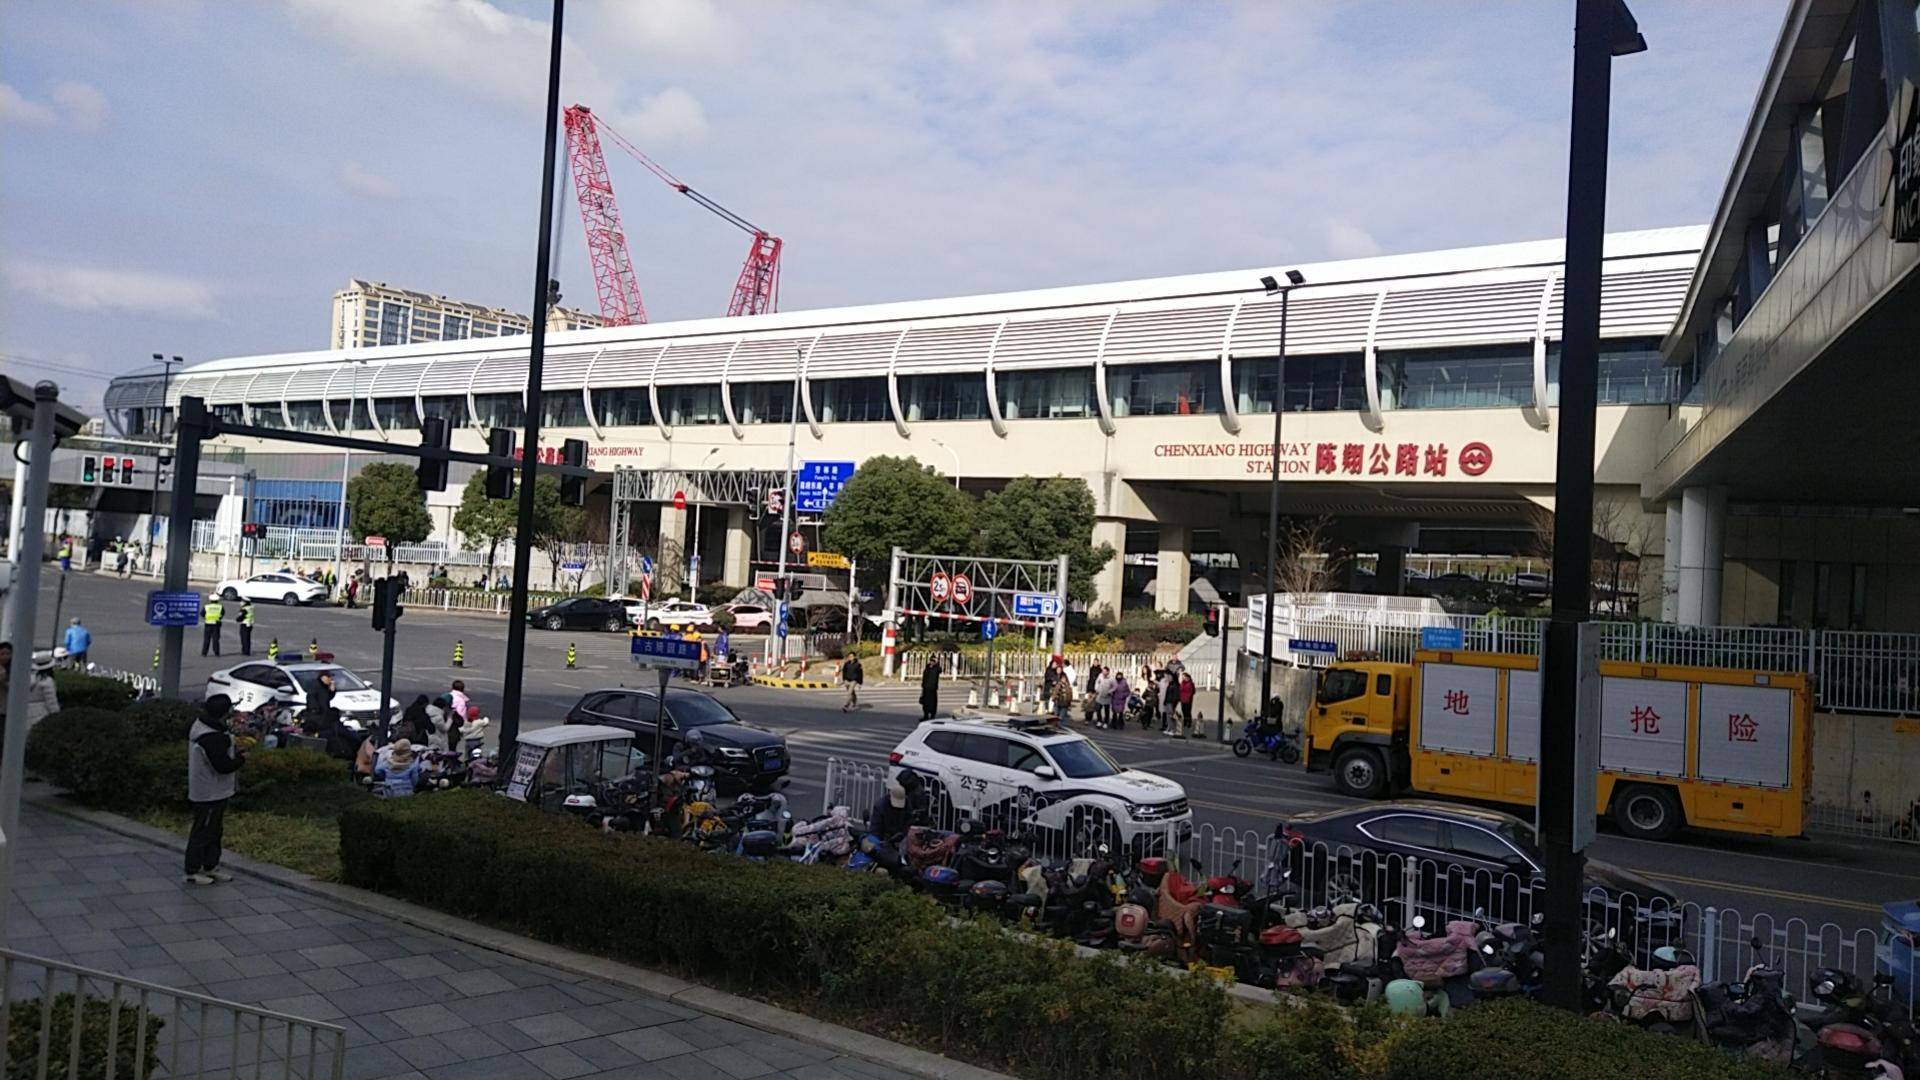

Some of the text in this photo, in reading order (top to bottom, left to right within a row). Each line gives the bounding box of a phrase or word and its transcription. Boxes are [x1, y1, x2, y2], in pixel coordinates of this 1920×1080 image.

[1896, 188, 1920, 241] INC
[609, 447, 645, 457] HIGHWAY
[1154, 443, 1312, 457] CHENXIANG HIGHWAY
[1246, 460, 1311, 474] STATION
[1315, 442, 1449, 477] 陈翔公路站
[1443, 688, 1760, 743] 地 抢 险
[960, 776, 988, 794] 公安
